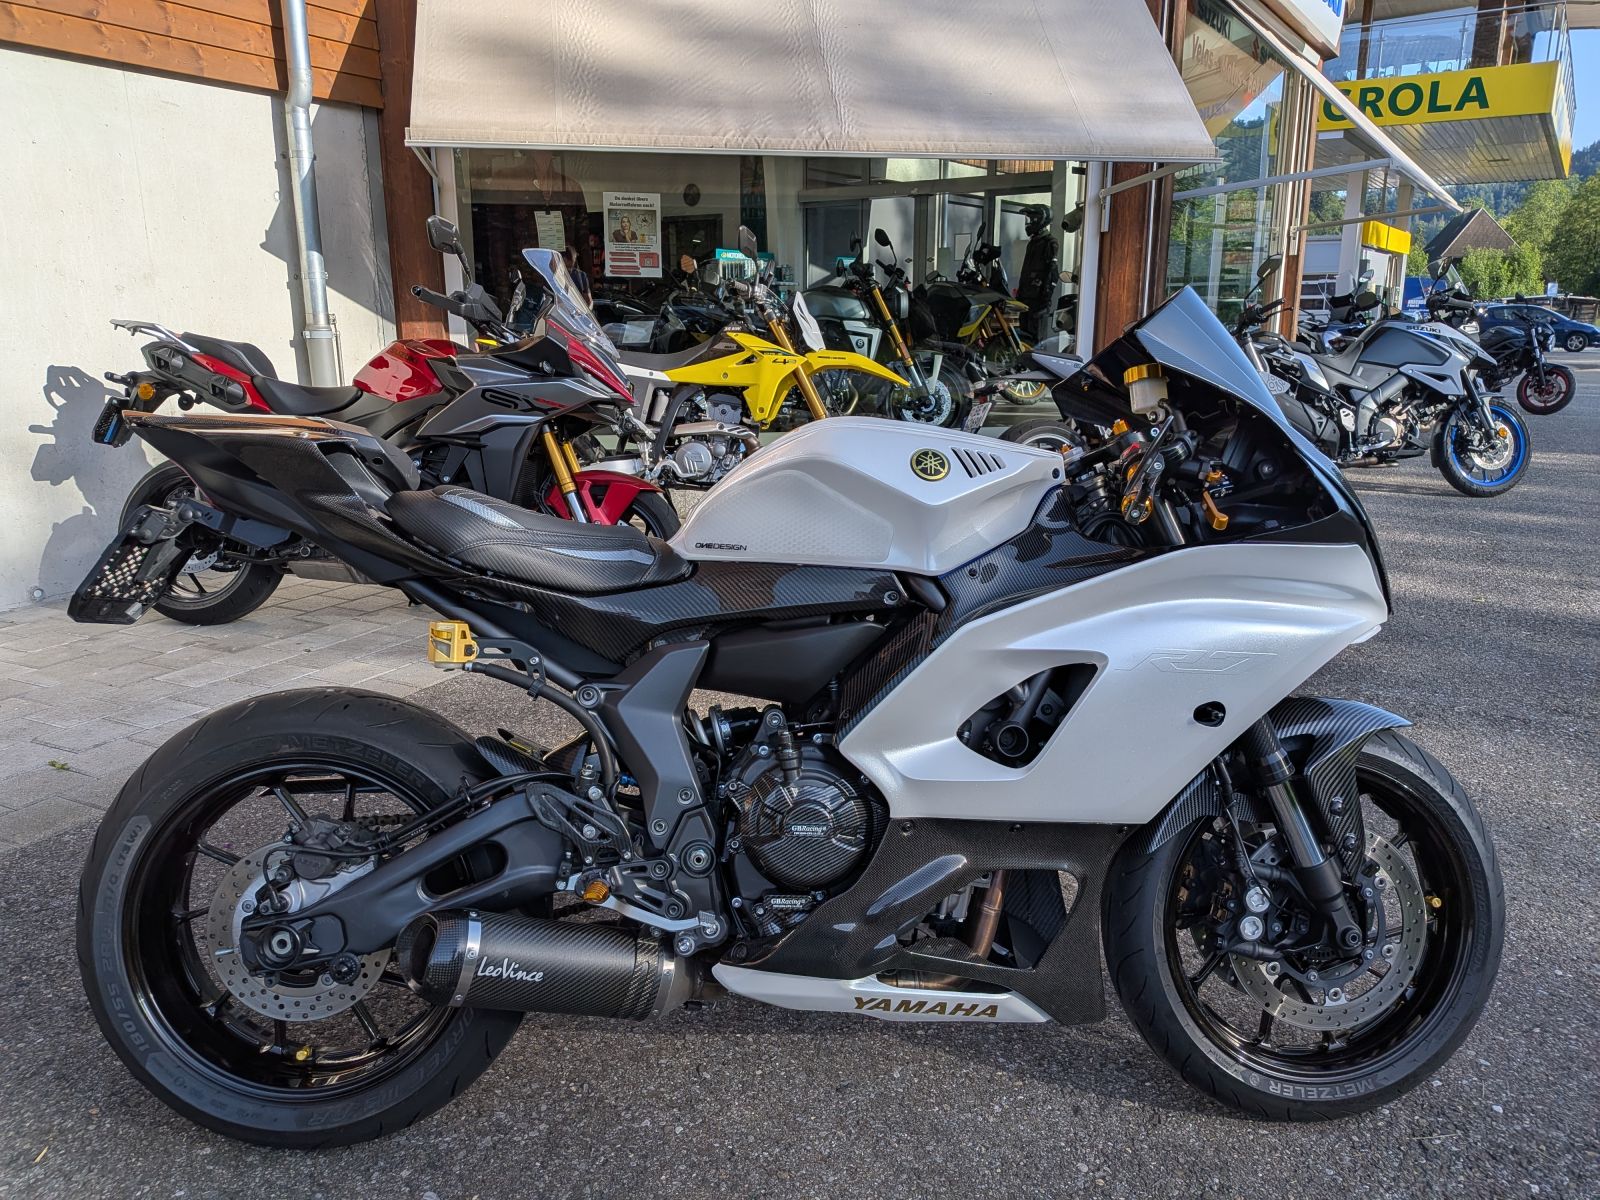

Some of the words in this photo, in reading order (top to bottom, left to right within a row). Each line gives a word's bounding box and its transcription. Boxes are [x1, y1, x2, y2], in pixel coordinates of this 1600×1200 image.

[1198, 4, 1231, 40] SUZUKI
[1317, 77, 1490, 123] GROLA
[1406, 325, 1441, 334] SUZUKI
[695, 542, 747, 551] ONEDESIGN
[477, 956, 544, 982] LeoVince
[107, 983, 150, 1051] 180/55
[854, 996, 999, 1018] YAMAHA
[1269, 1077, 1376, 1099] METZELER
